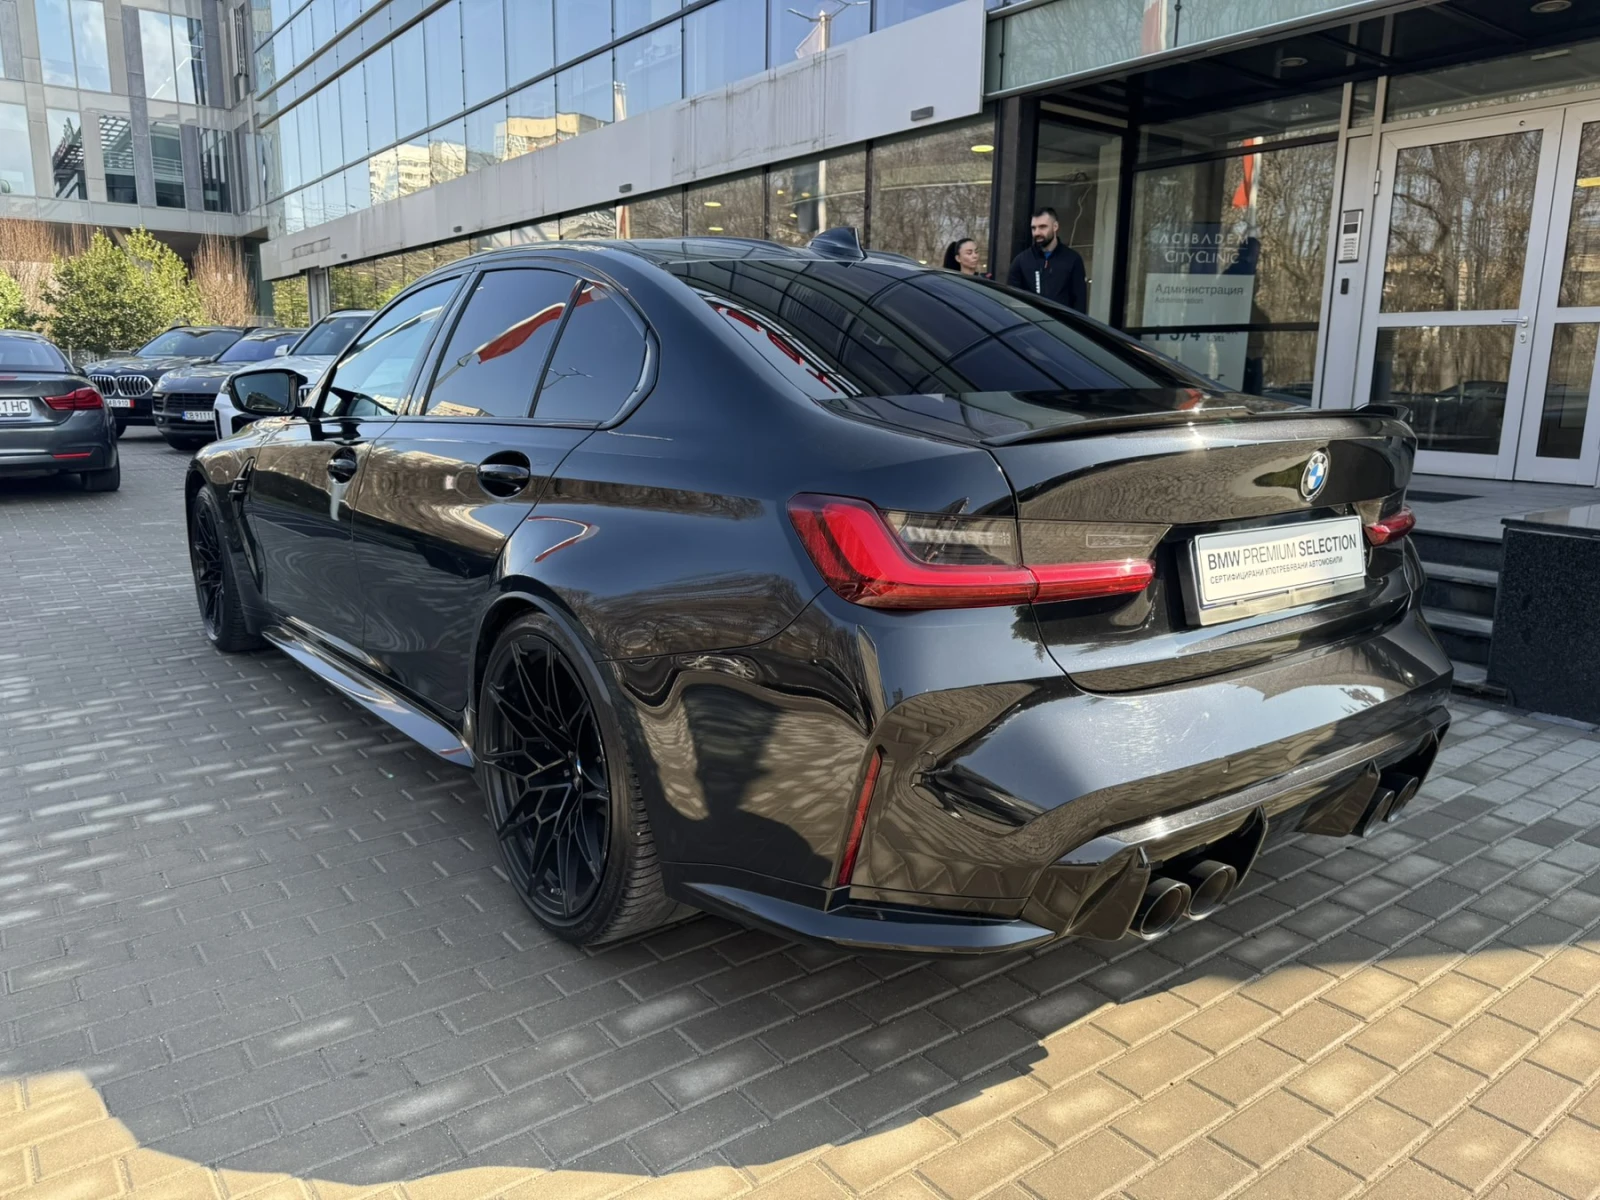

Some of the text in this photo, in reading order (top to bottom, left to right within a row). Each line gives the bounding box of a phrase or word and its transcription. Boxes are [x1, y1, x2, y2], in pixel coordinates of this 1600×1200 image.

[1159, 232, 1249, 244] ACIBADEM
[1155, 283, 1244, 297] Администрация
[10, 400, 28, 412] HC
[1207, 533, 1357, 571] BMW PREMIUM SELECTION
[1210, 555, 1343, 585] СЕРТИФИЦИРАНИ УПОТРЕБЯВАНИ АВТОМОБИЛИ
